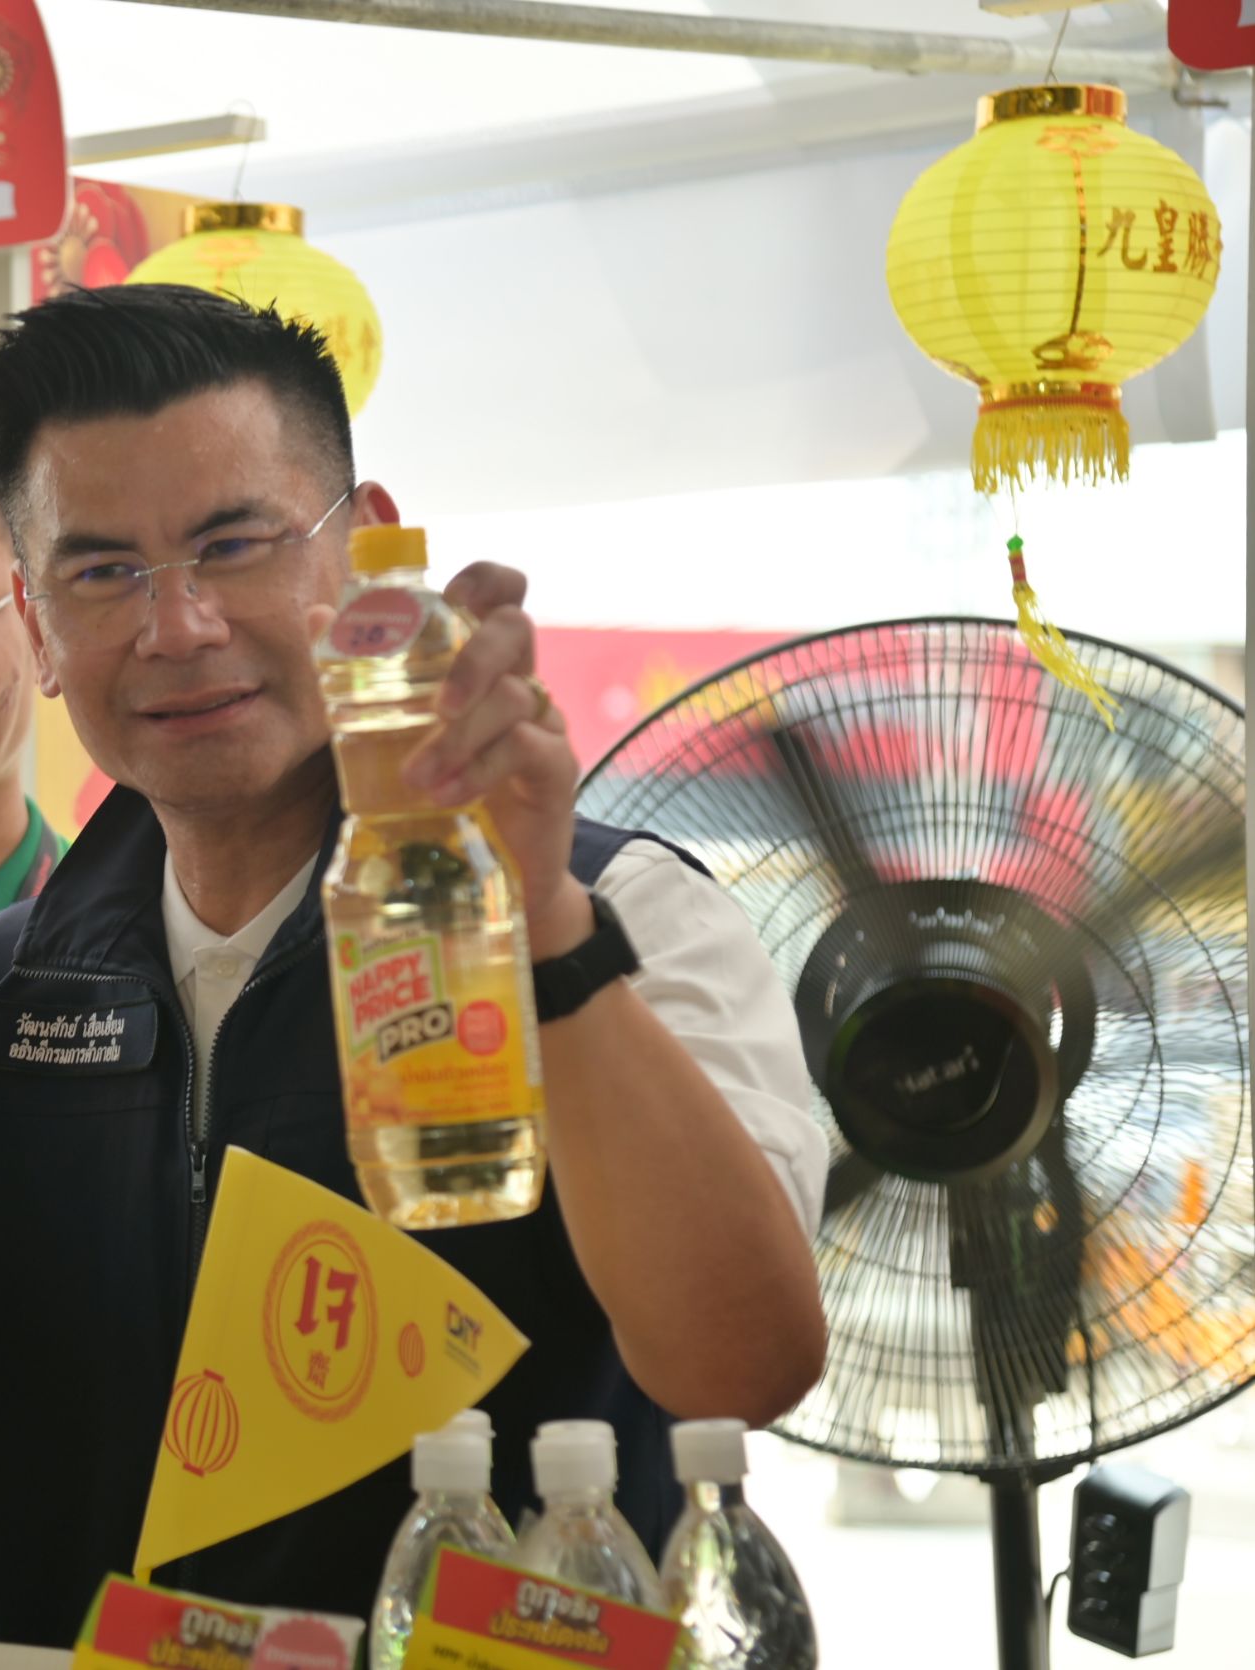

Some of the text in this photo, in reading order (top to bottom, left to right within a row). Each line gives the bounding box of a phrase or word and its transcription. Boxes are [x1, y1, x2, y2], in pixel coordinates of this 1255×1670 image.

[350, 950, 422, 1005] HAPPY
[354, 975, 433, 1033] PRICE
[379, 1006, 452, 1060] PRO
